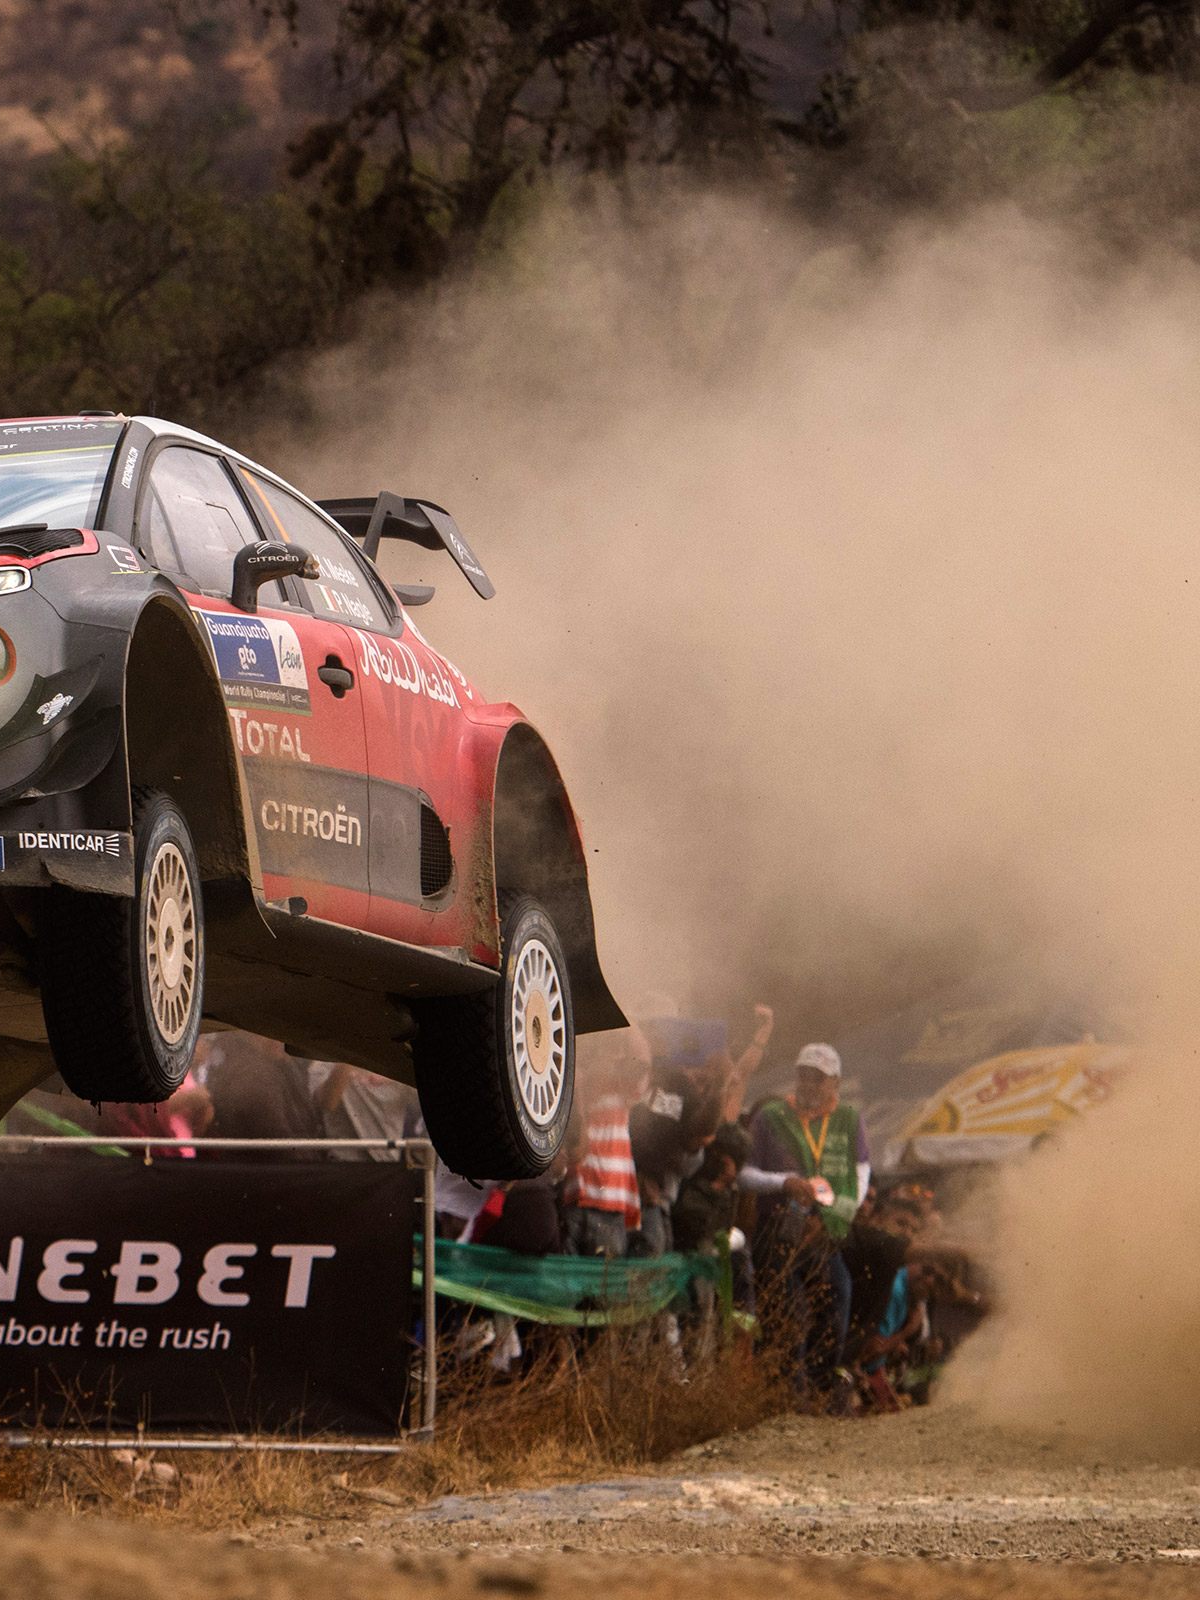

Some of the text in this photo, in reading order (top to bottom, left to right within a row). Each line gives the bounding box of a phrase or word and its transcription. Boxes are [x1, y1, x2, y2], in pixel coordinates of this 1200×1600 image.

[206, 617, 270, 644] Guanajuato
[238, 644, 257, 670] gto
[229, 708, 311, 763] TOTAL
[261, 800, 362, 847] CITROËN
[19, 832, 105, 853] IDENTICAR
[95, 1320, 148, 1348] the
[159, 1321, 231, 1350] rush
